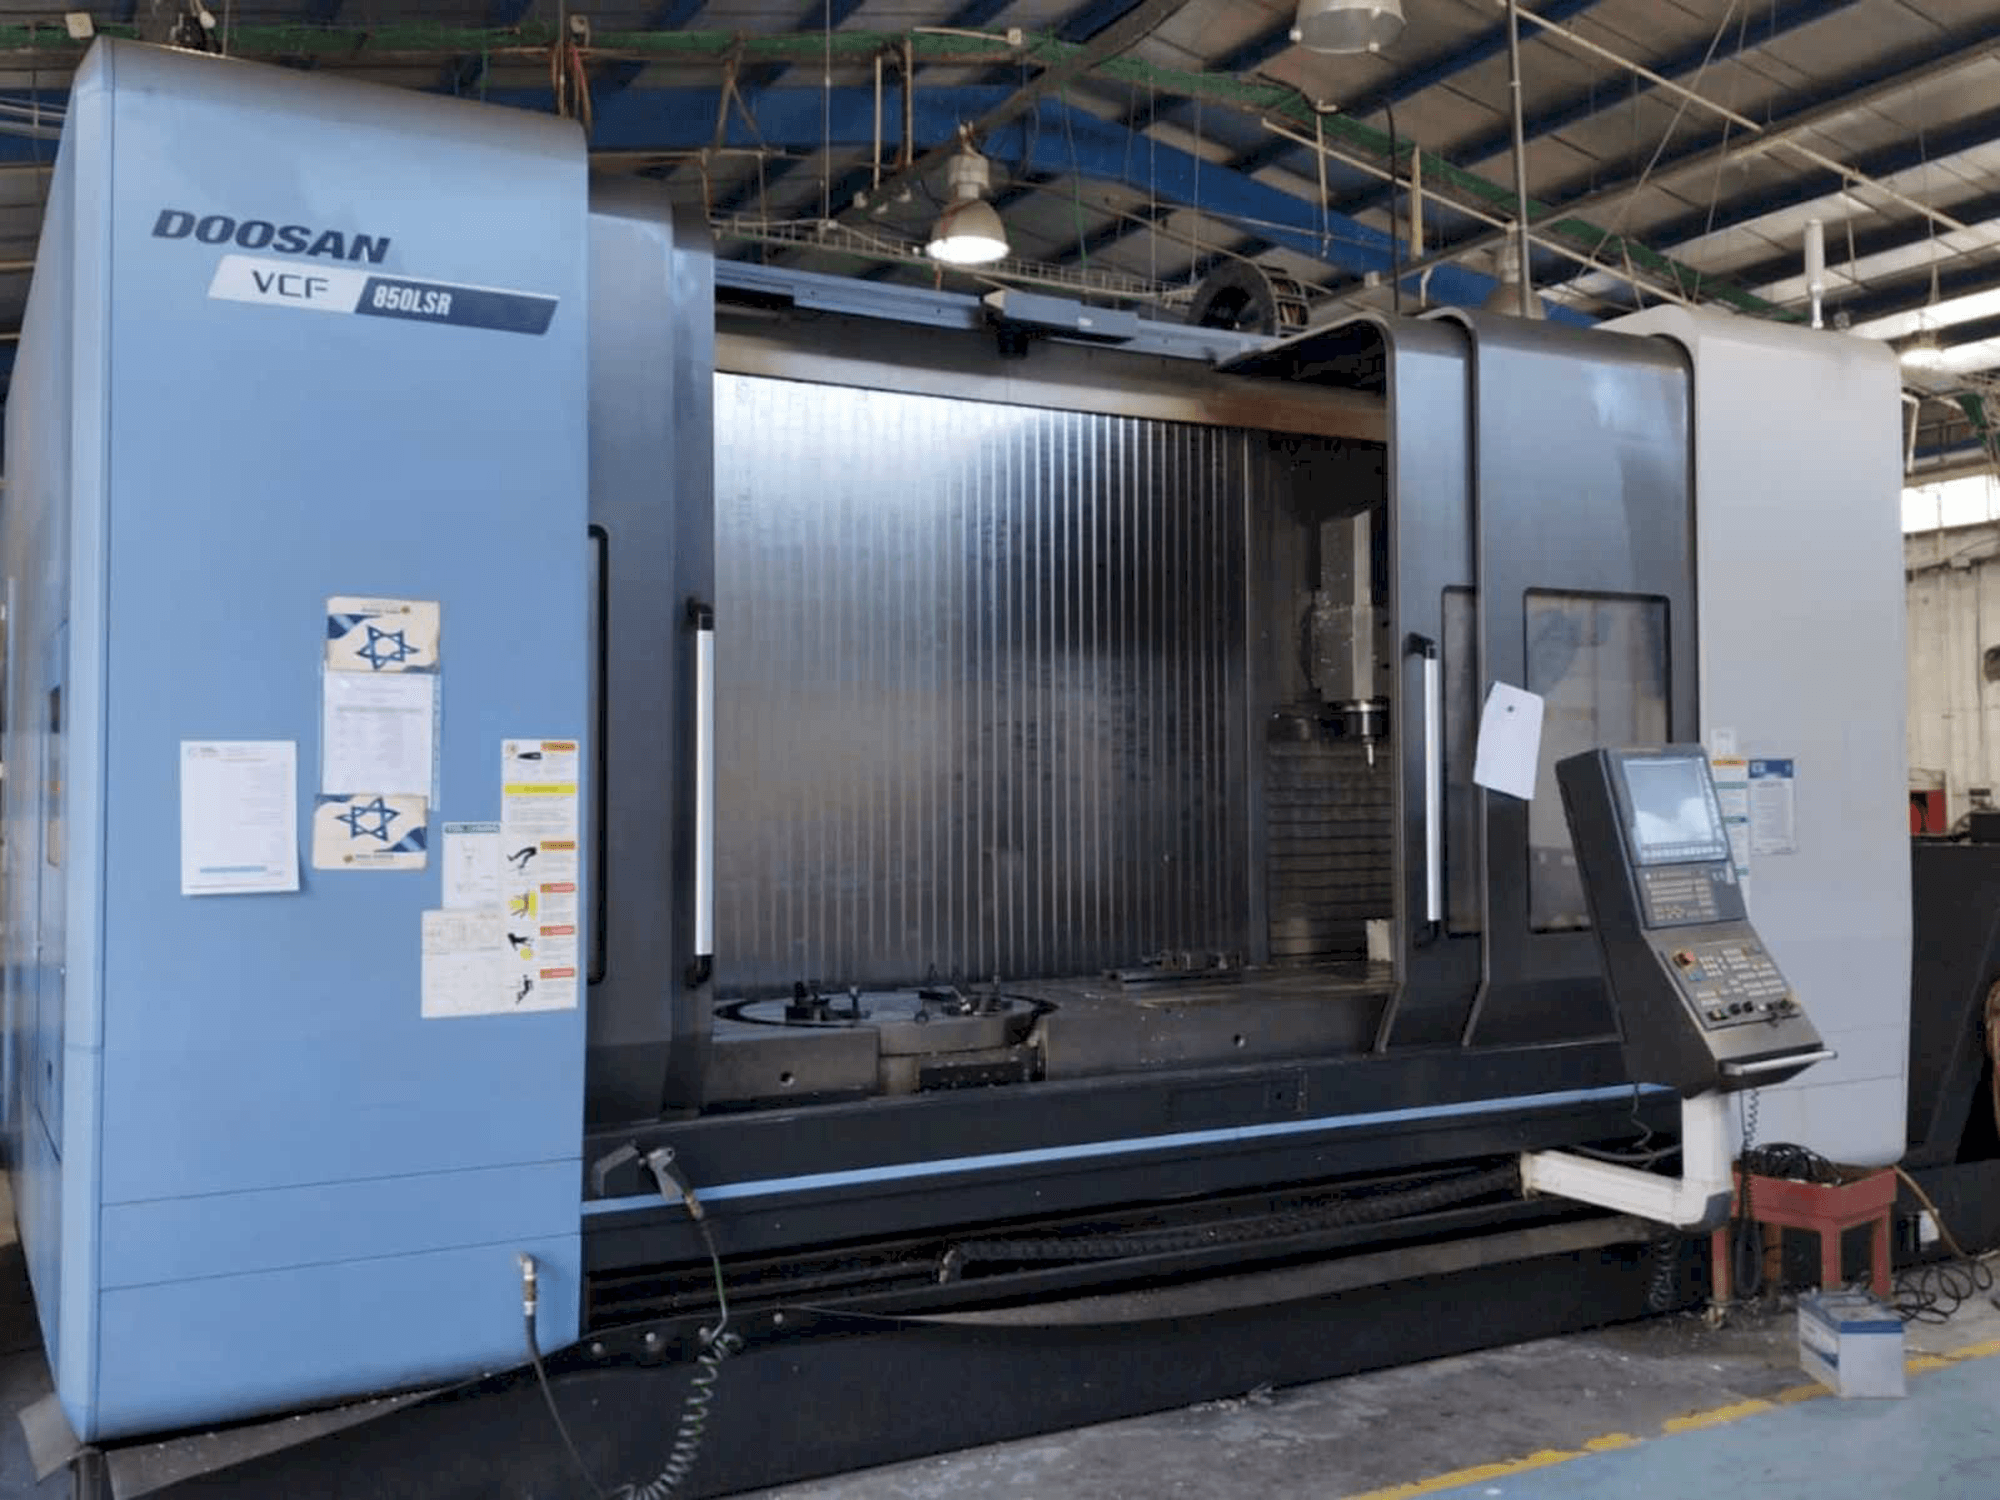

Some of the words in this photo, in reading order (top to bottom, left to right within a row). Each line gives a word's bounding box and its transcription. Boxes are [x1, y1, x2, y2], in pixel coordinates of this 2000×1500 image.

[152, 209, 391, 264] DOOSAN
[251, 270, 329, 300] VCF
[372, 284, 452, 316] 850LSR
